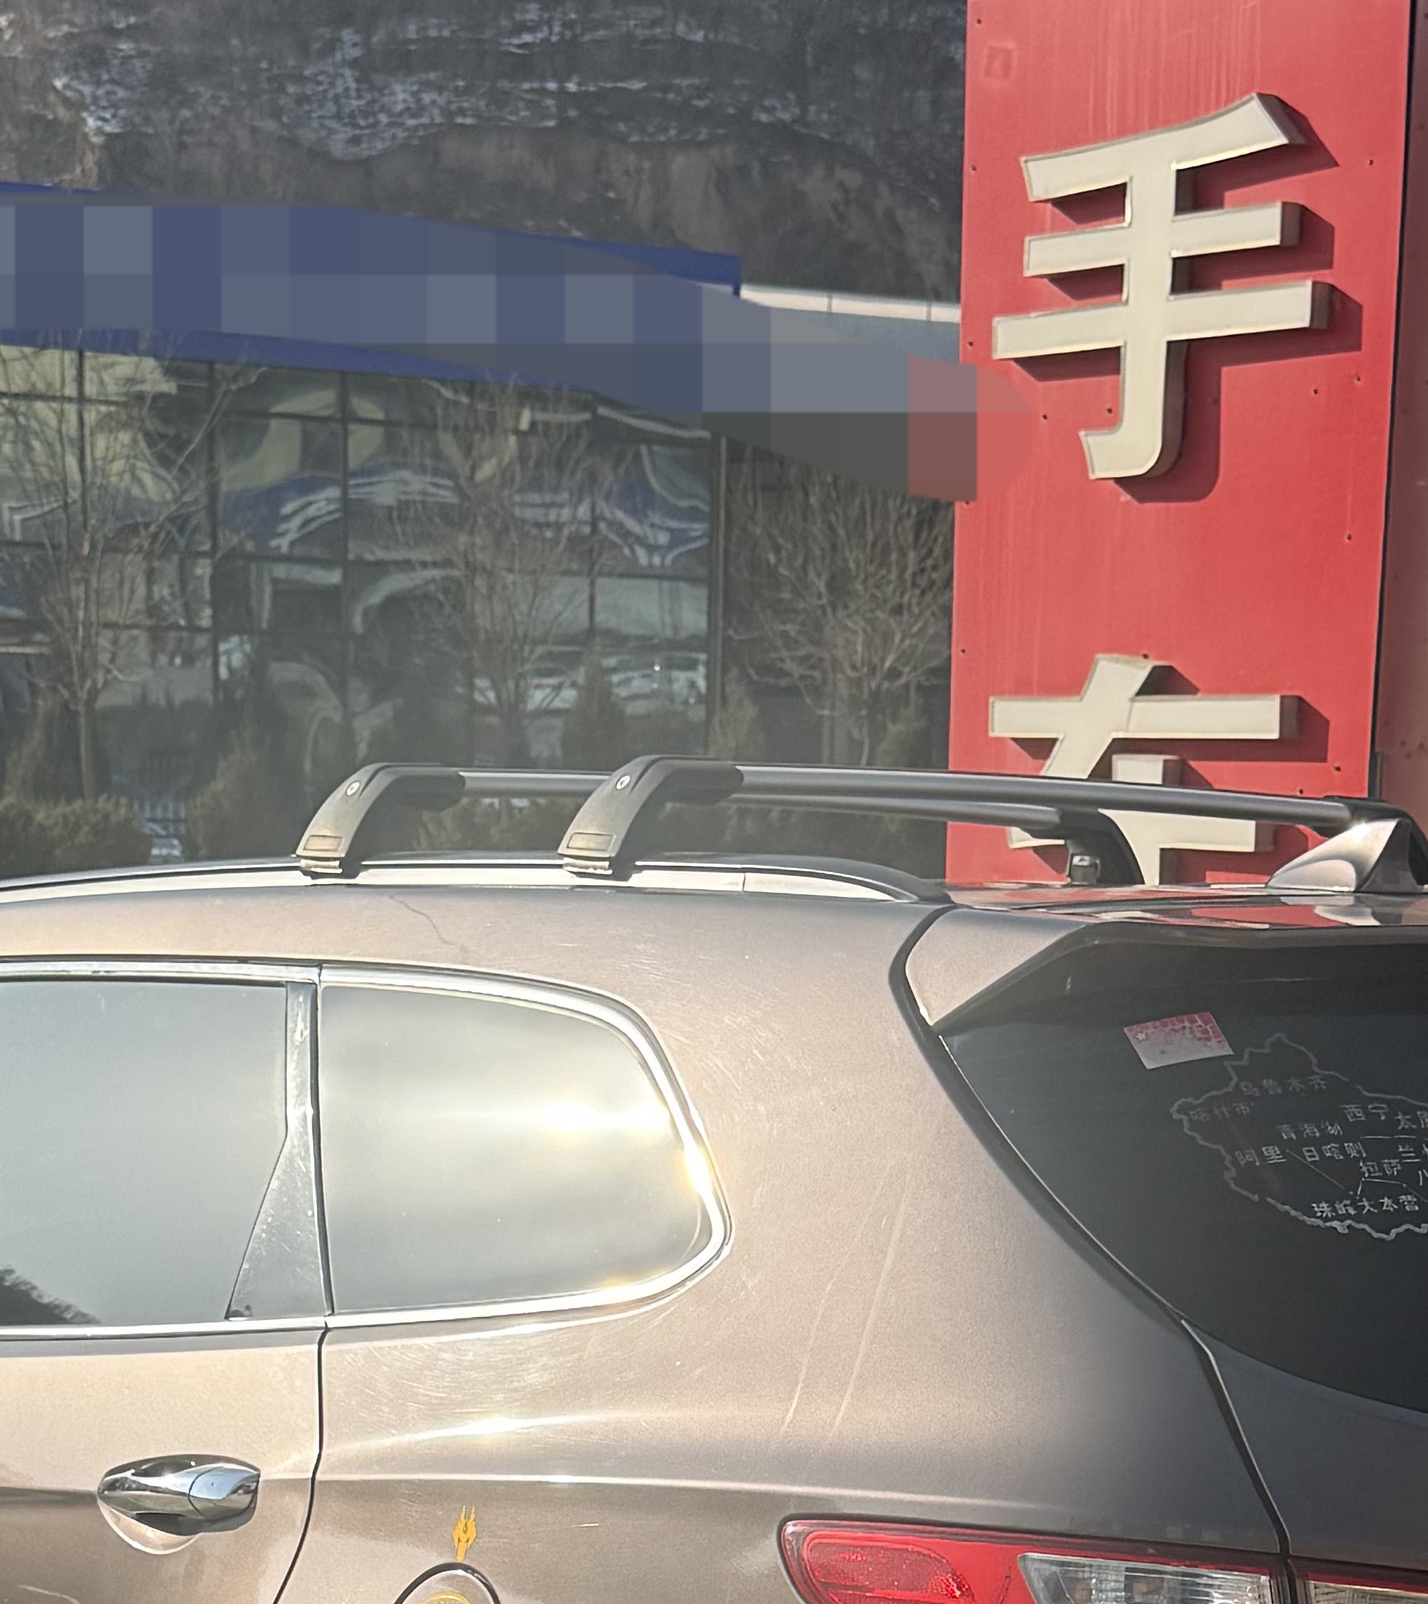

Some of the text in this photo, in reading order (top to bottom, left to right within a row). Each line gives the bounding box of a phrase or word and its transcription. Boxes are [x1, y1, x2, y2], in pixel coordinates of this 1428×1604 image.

[1339, 1103, 1390, 1122] 西宁
[1234, 1145, 1287, 1166] 阿里
[1360, 1158, 1403, 1178] 拉萨
